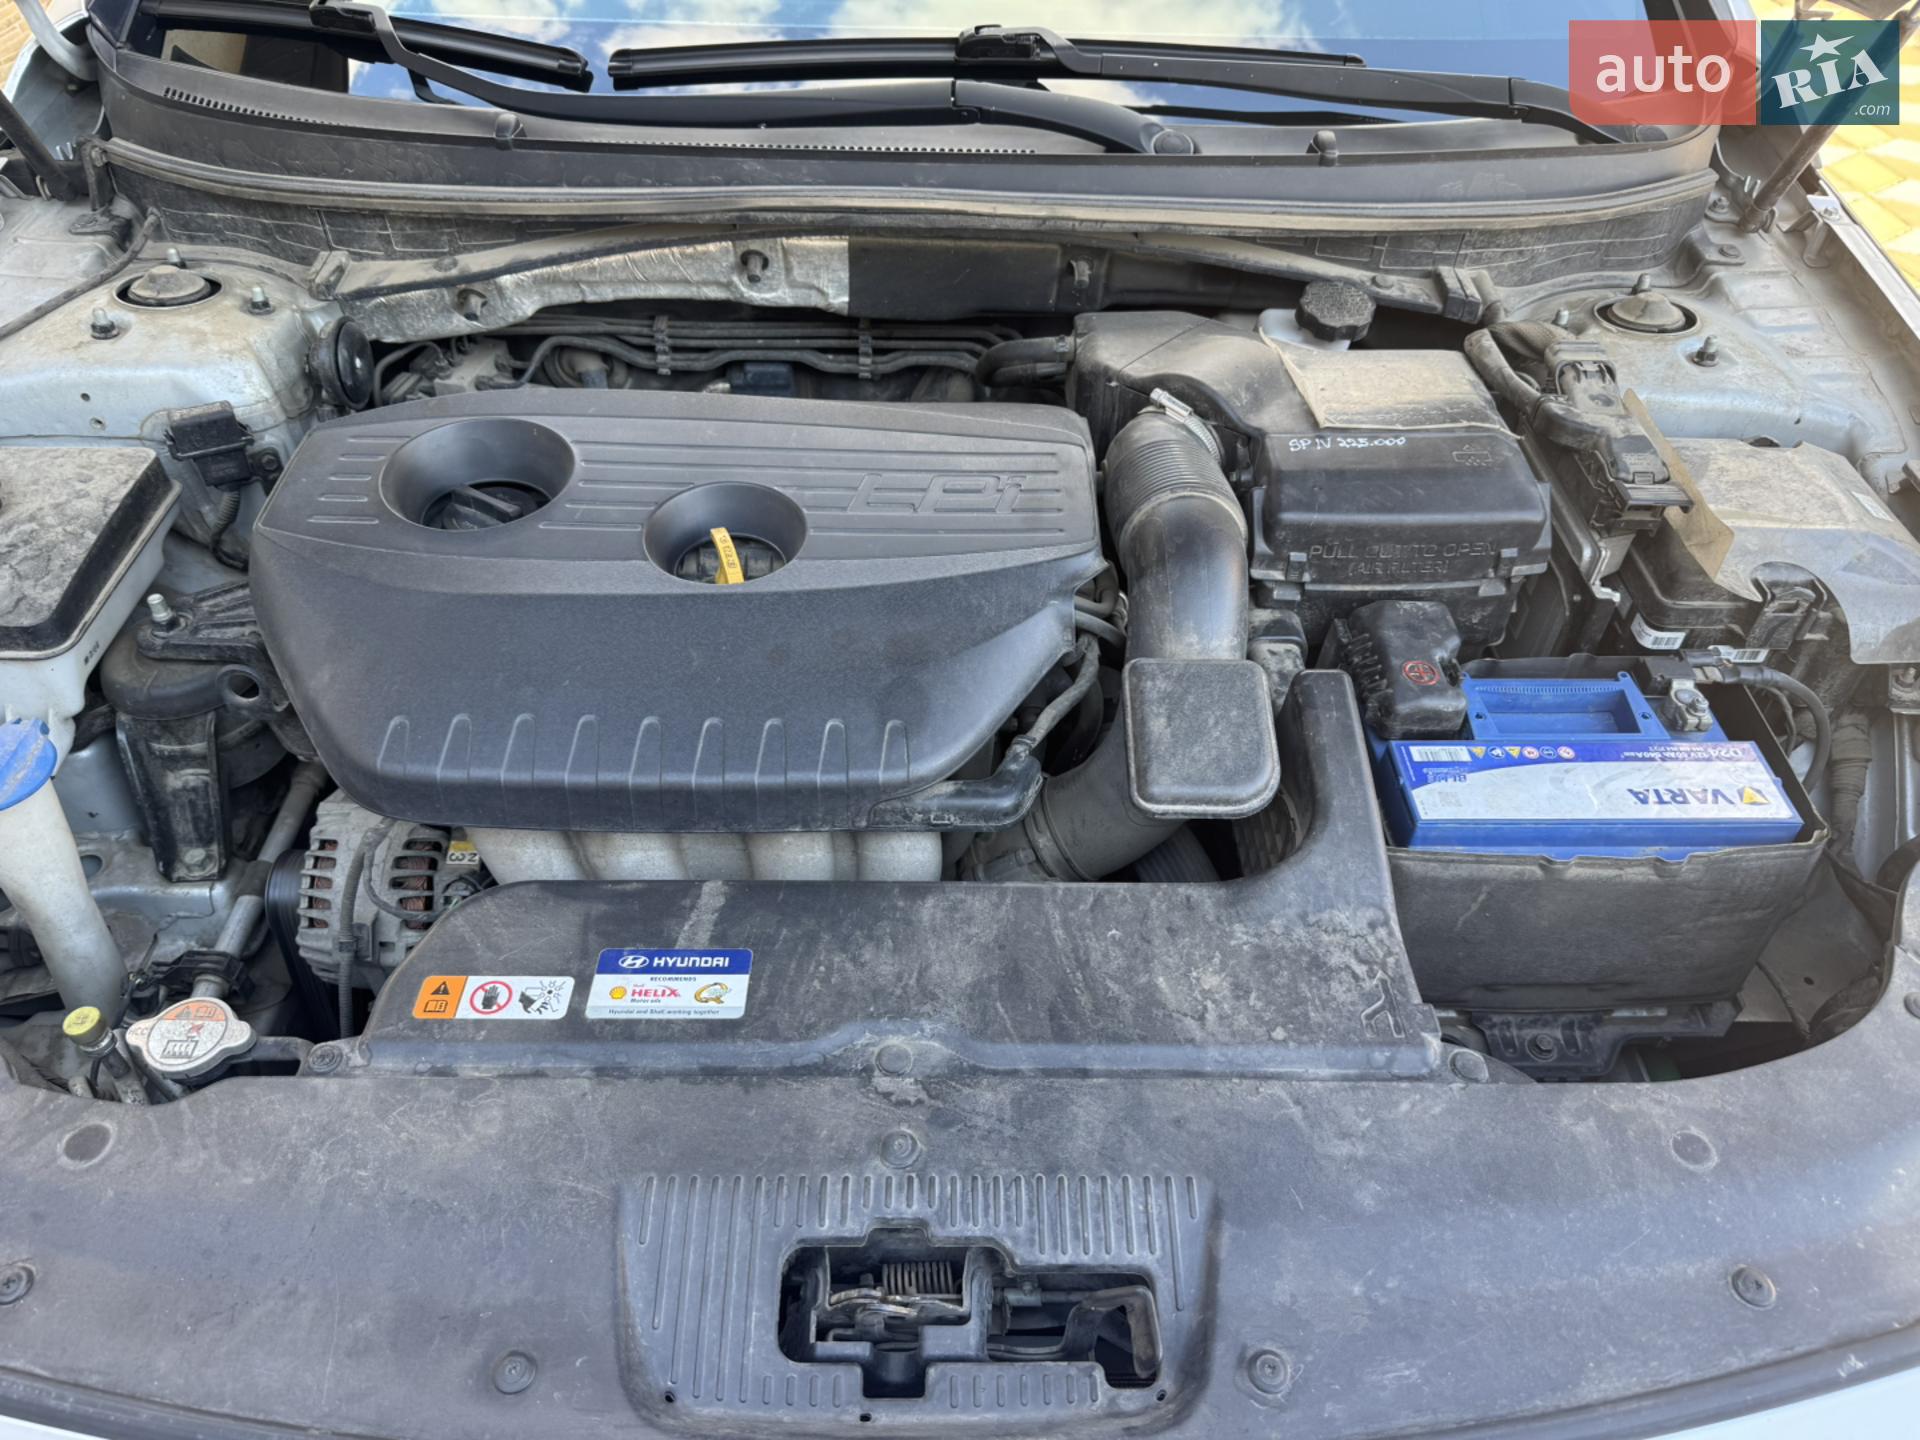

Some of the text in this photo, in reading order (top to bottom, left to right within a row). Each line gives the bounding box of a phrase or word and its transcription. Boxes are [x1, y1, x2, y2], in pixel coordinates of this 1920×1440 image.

[1308, 542, 1498, 559] PULL OUT TO OPEN
[1427, 773, 1467, 783] BLUE
[1626, 788, 1736, 806] VARTA
[653, 956, 730, 968] HYUNDAI
[631, 988, 679, 998] HELIX
